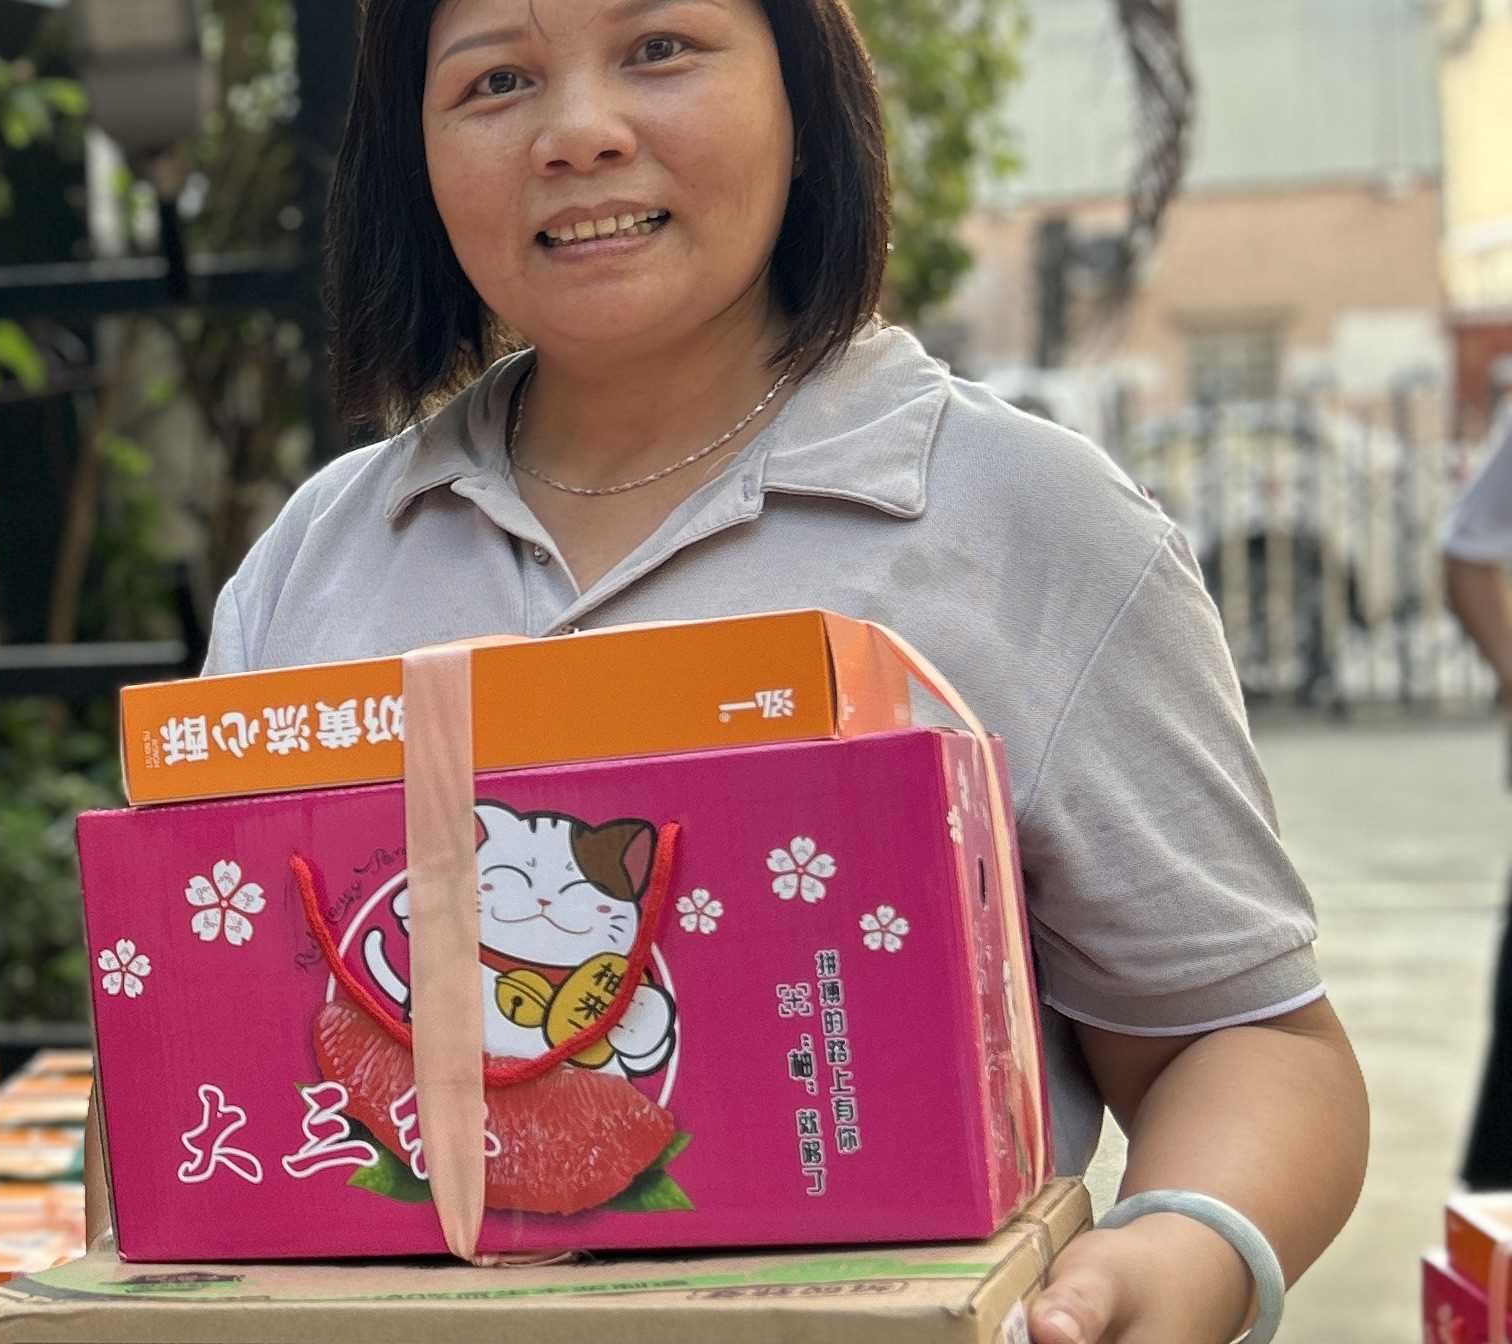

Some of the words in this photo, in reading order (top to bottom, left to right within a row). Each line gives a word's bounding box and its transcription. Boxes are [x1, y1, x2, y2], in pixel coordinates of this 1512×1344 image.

[814, 949, 862, 1154] 拼搏的路上有你
